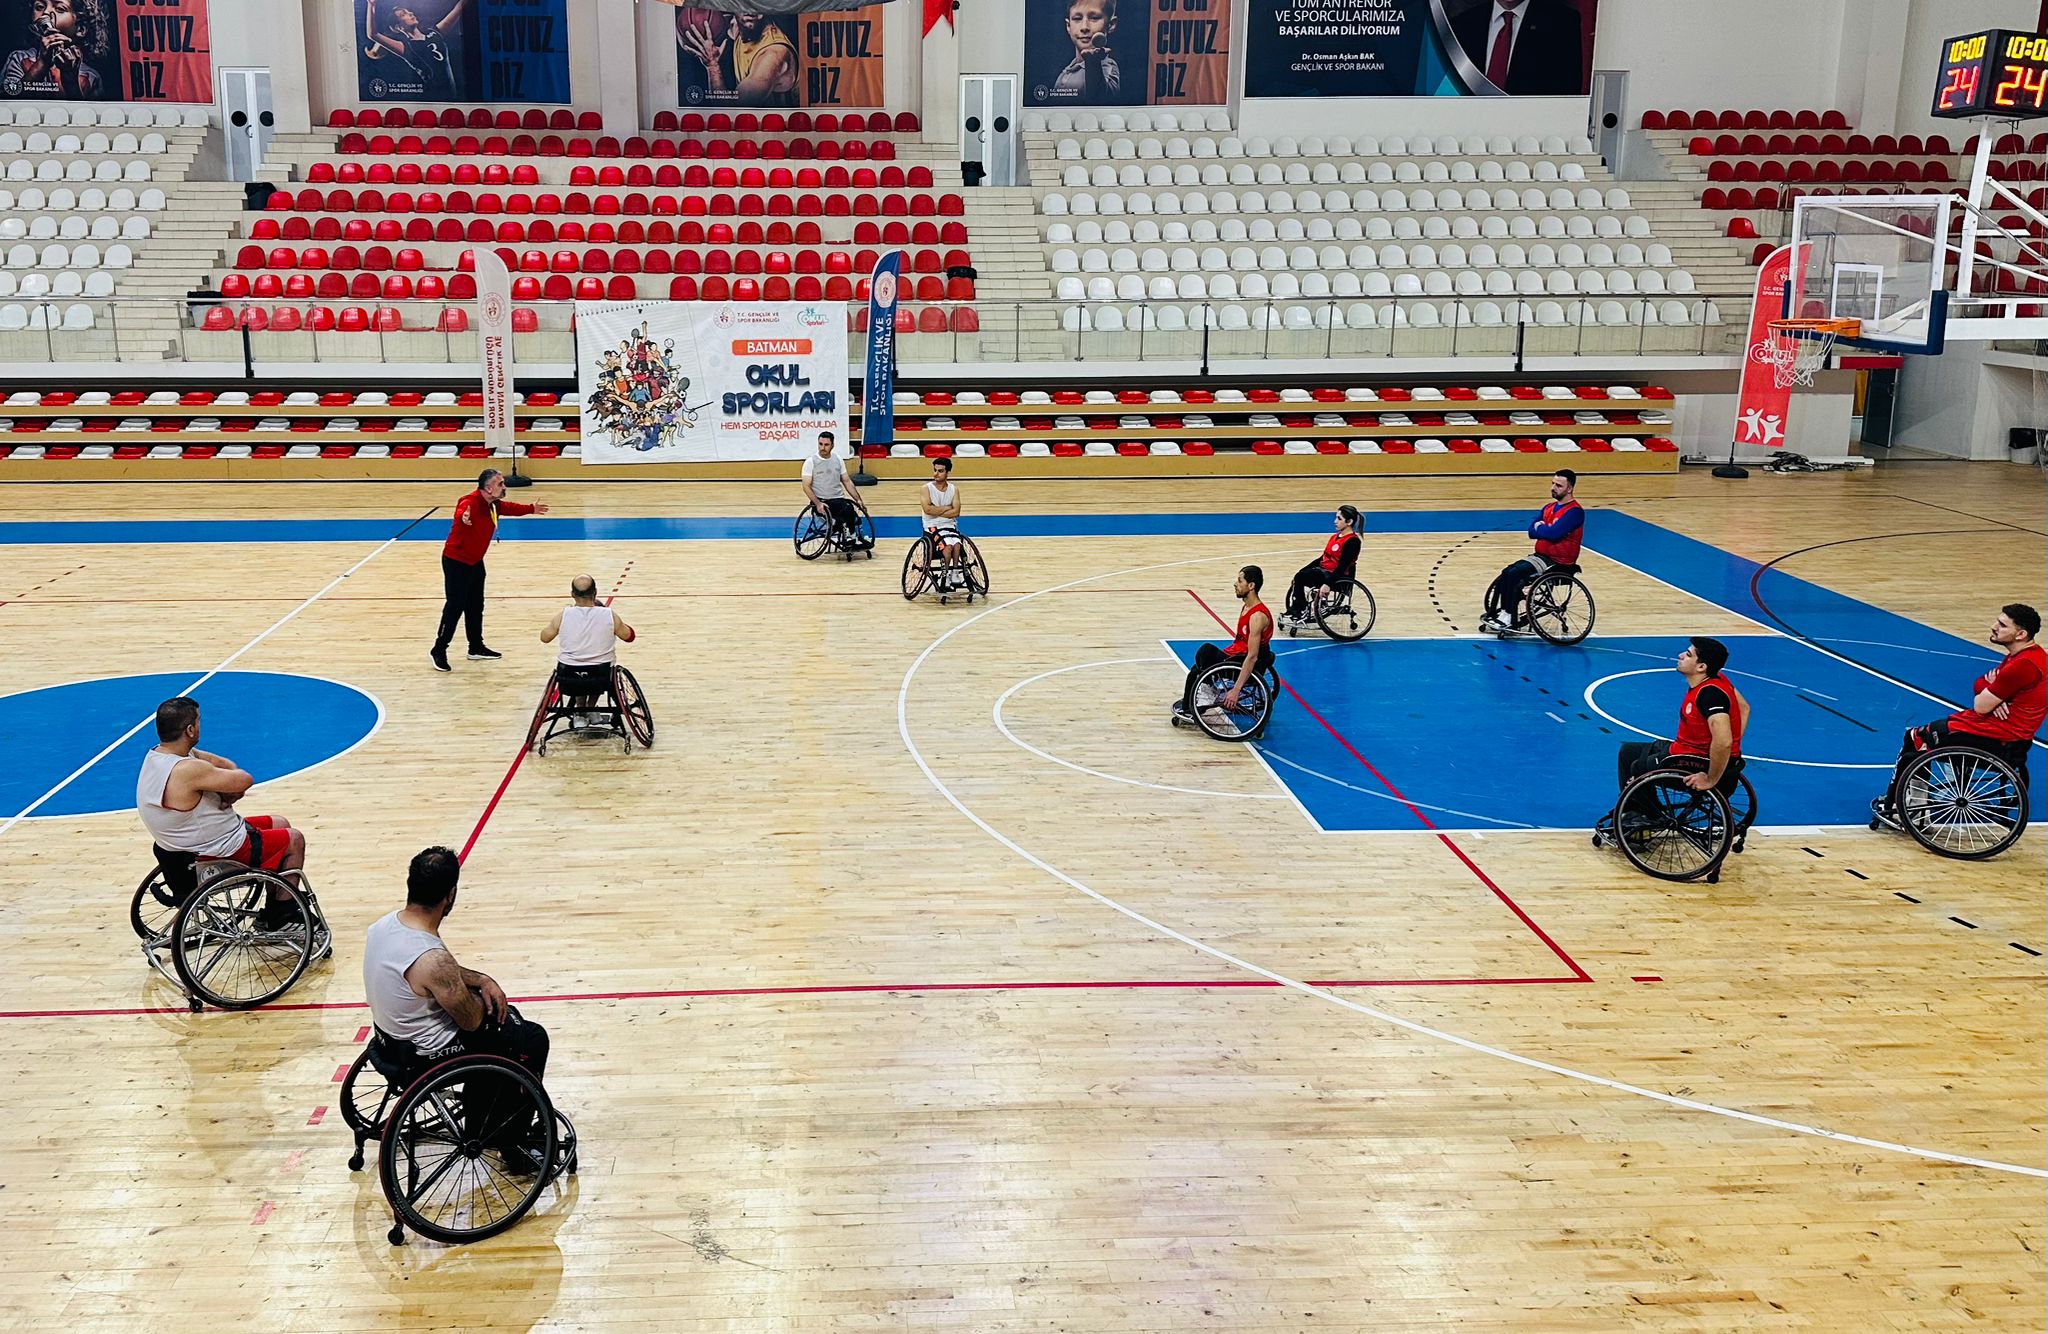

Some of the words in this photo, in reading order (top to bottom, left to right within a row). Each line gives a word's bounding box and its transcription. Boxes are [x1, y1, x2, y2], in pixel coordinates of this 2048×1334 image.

[1275, 10, 1291, 22] VE
[1294, 10, 1406, 22] SPORCULARIMIZA
[1279, 26, 1338, 38] BAŞARILAR
[1340, 24, 1400, 36] DİLİYORUM
[426, 42, 444, 61] 3
[1948, 36, 1987, 63] 10:00
[130, 57, 166, 99] BİZ
[1291, 62, 1322, 72] GENÇLİK
[808, 63, 840, 104] BİZ
[1156, 59, 1187, 98] BİZ
[1939, 66, 1980, 108] 24
[1995, 65, 2048, 108] 24
[747, 341, 797, 353] BATMAN
[746, 364, 810, 386] OKUL
[870, 391, 879, 413] T.C.
[875, 318, 884, 333] VE
[722, 391, 836, 414] SPORLARI
[760, 430, 800, 441] BAŞARI
[428, 1044, 465, 1060] EXTRA
